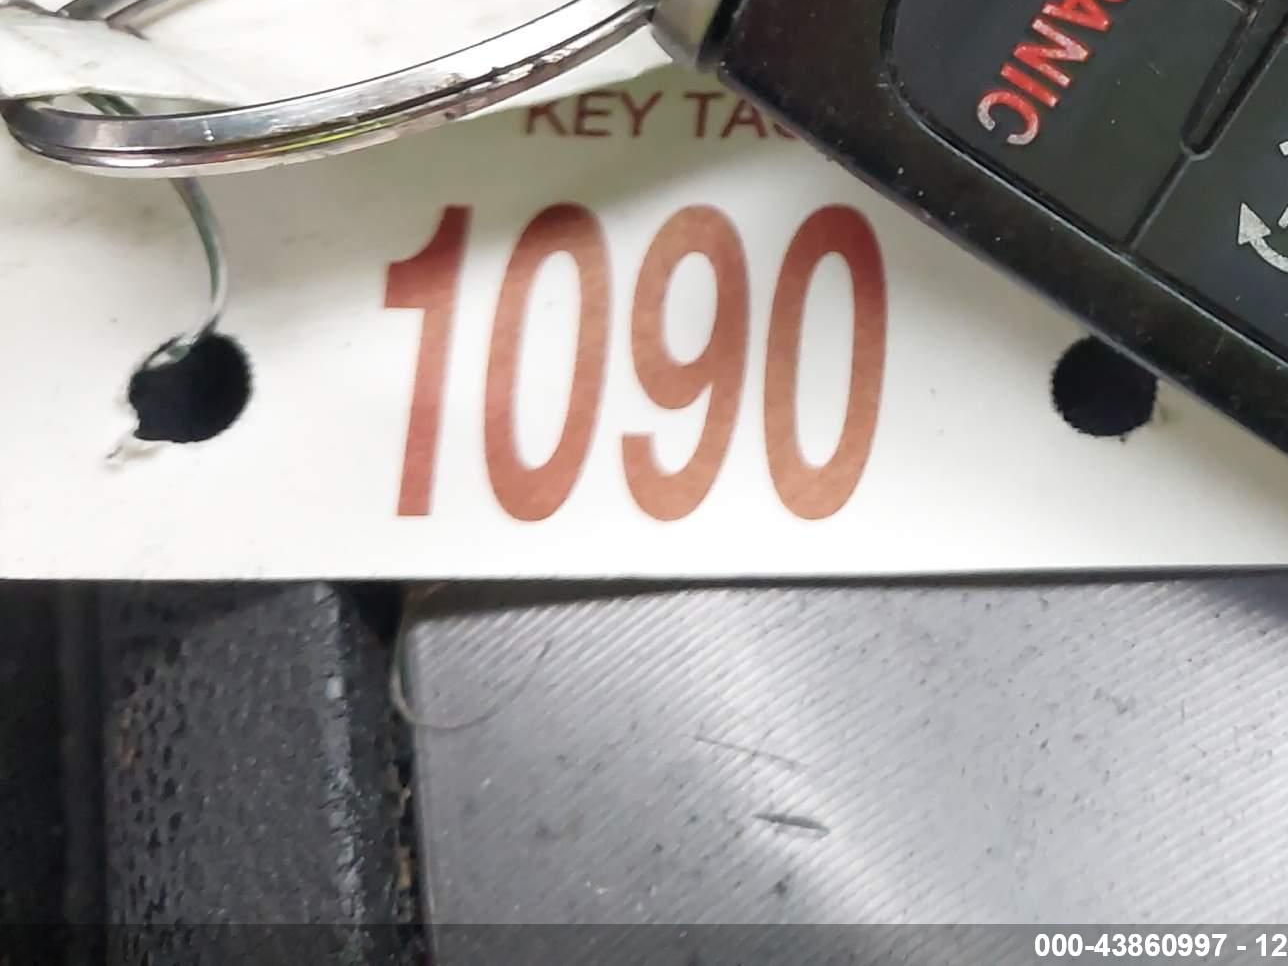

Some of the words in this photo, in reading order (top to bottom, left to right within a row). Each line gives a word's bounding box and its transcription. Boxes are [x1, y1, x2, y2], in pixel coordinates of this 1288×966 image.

[525, 88, 663, 138] KEY
[682, 91, 798, 139] TA
[383, 201, 888, 522] 1090
